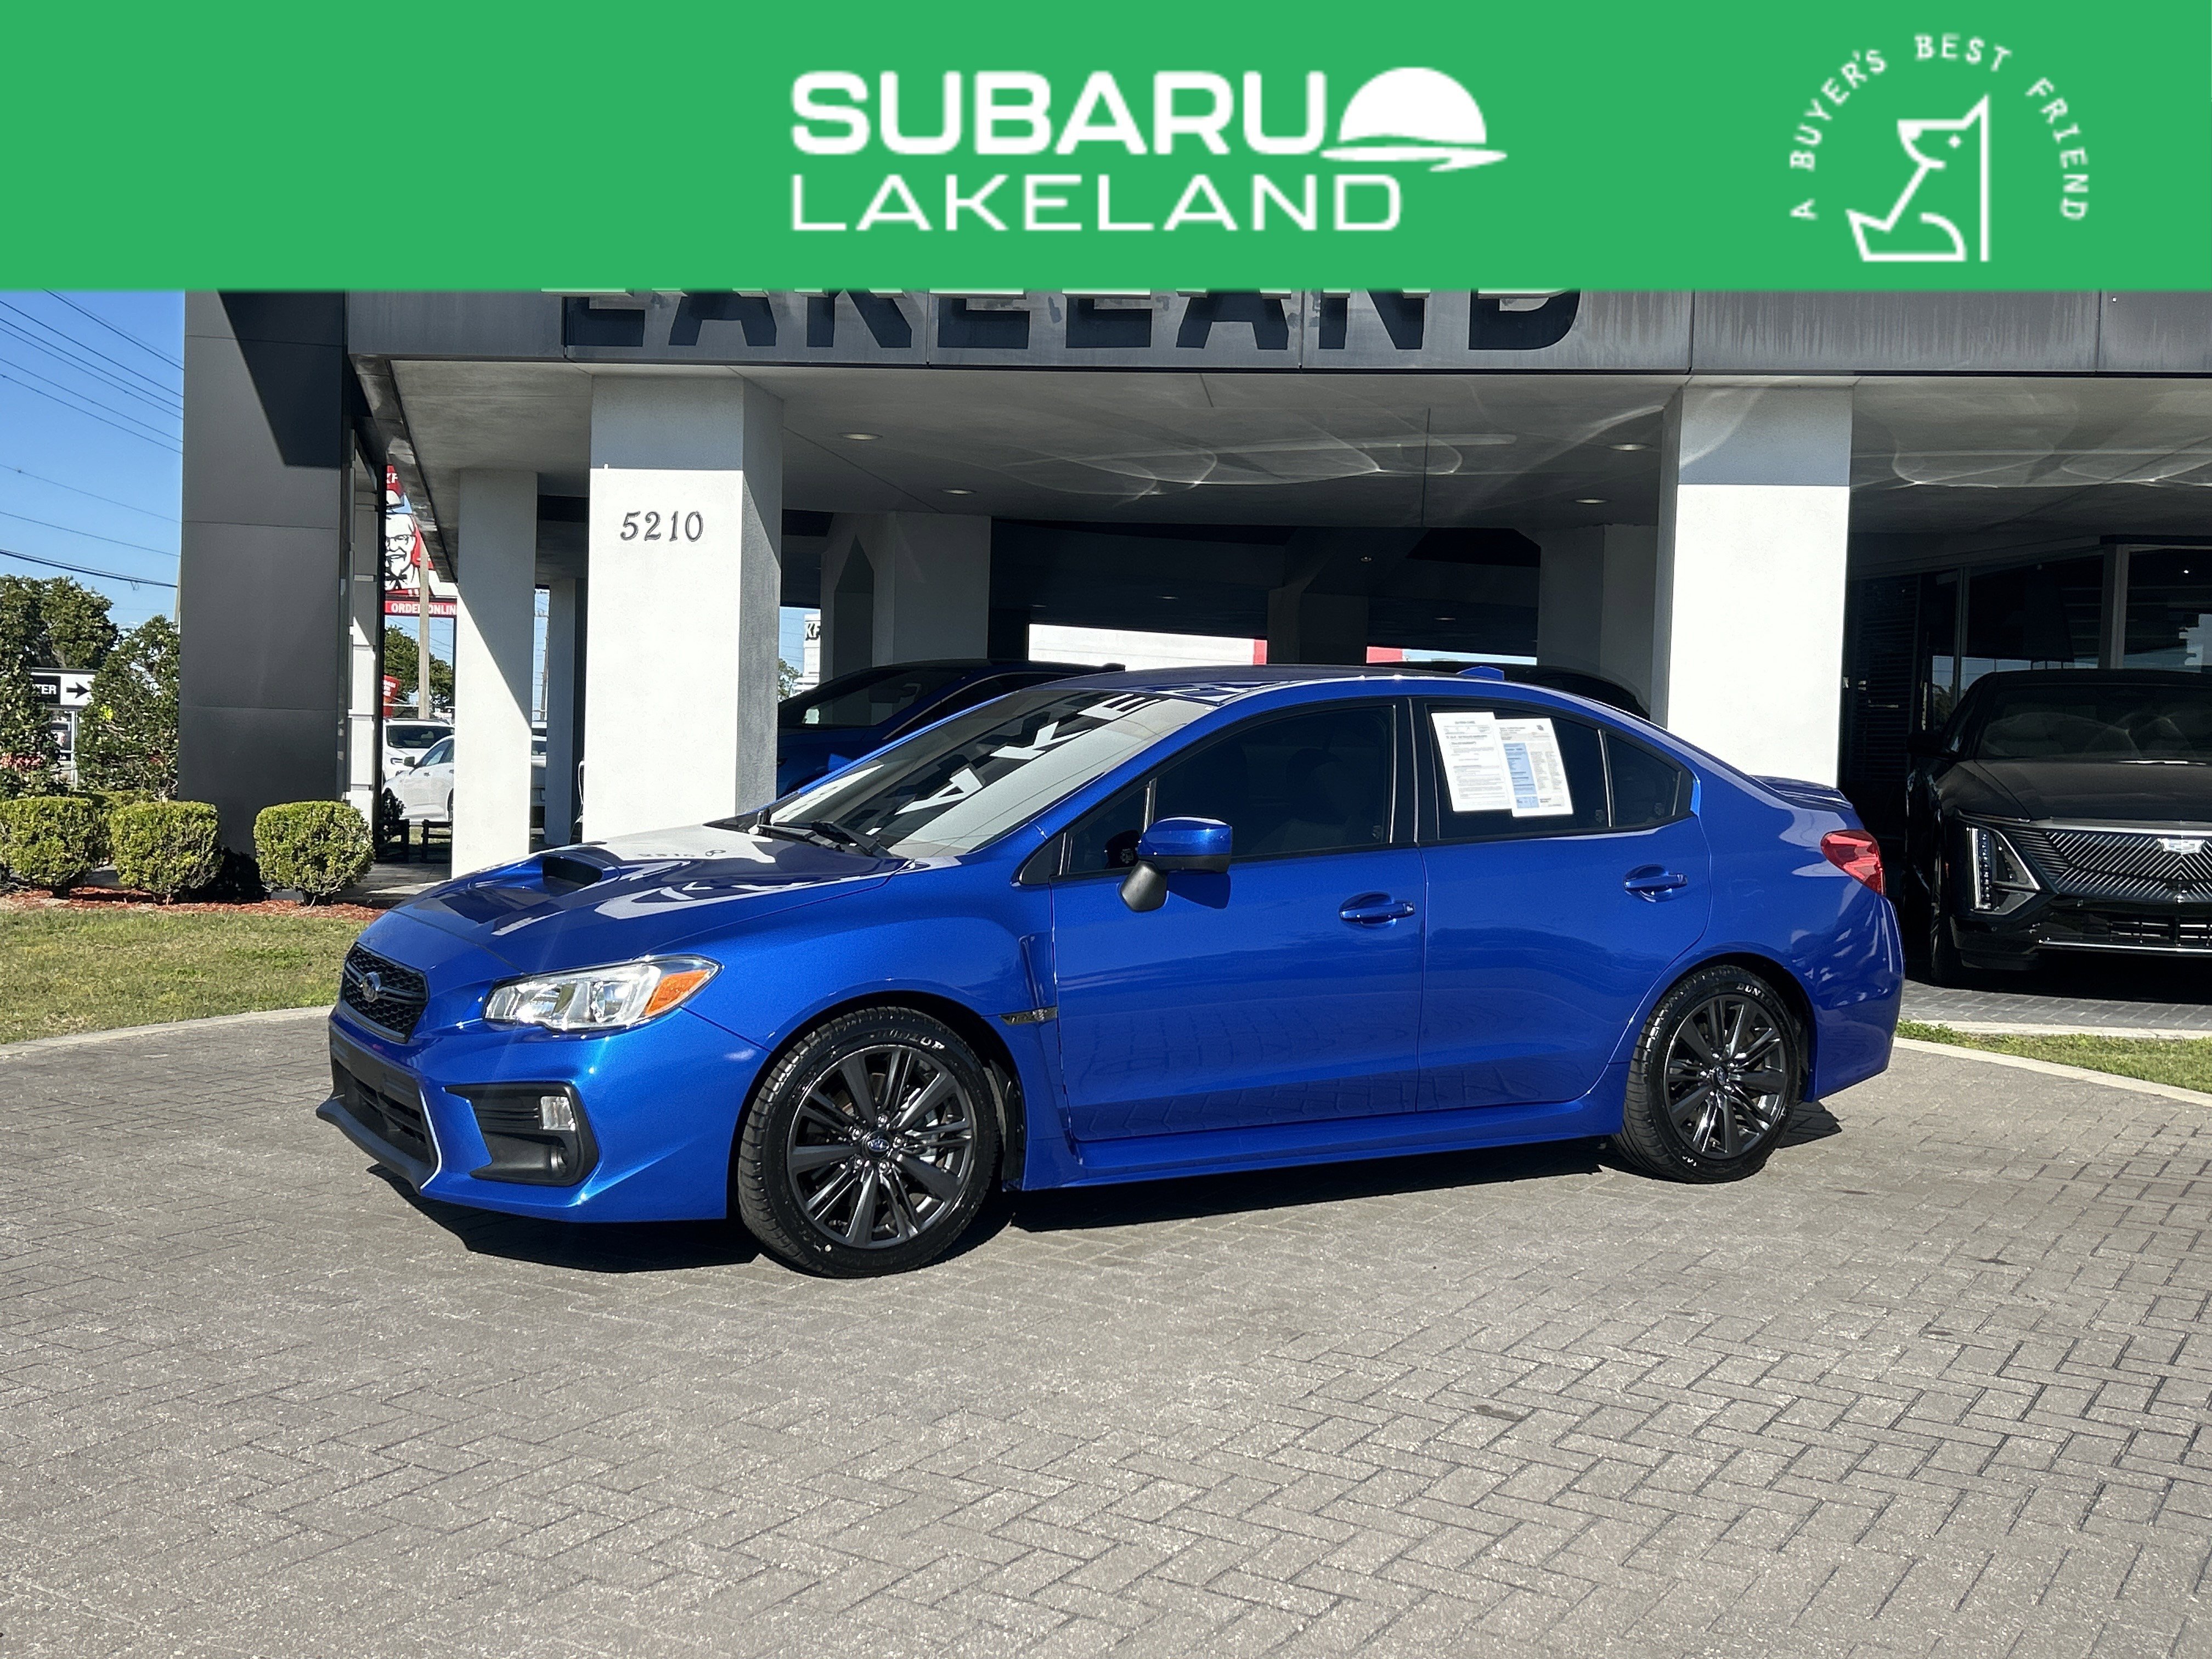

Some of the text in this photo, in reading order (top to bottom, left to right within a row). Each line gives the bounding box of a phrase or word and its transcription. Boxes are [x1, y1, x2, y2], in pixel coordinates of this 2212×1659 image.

[386, 472, 398, 484] KF
[620, 510, 703, 543] 5210
[428, 604, 457, 616] ONLIN
[805, 623, 821, 641] KF
[32, 684, 57, 695] TER
